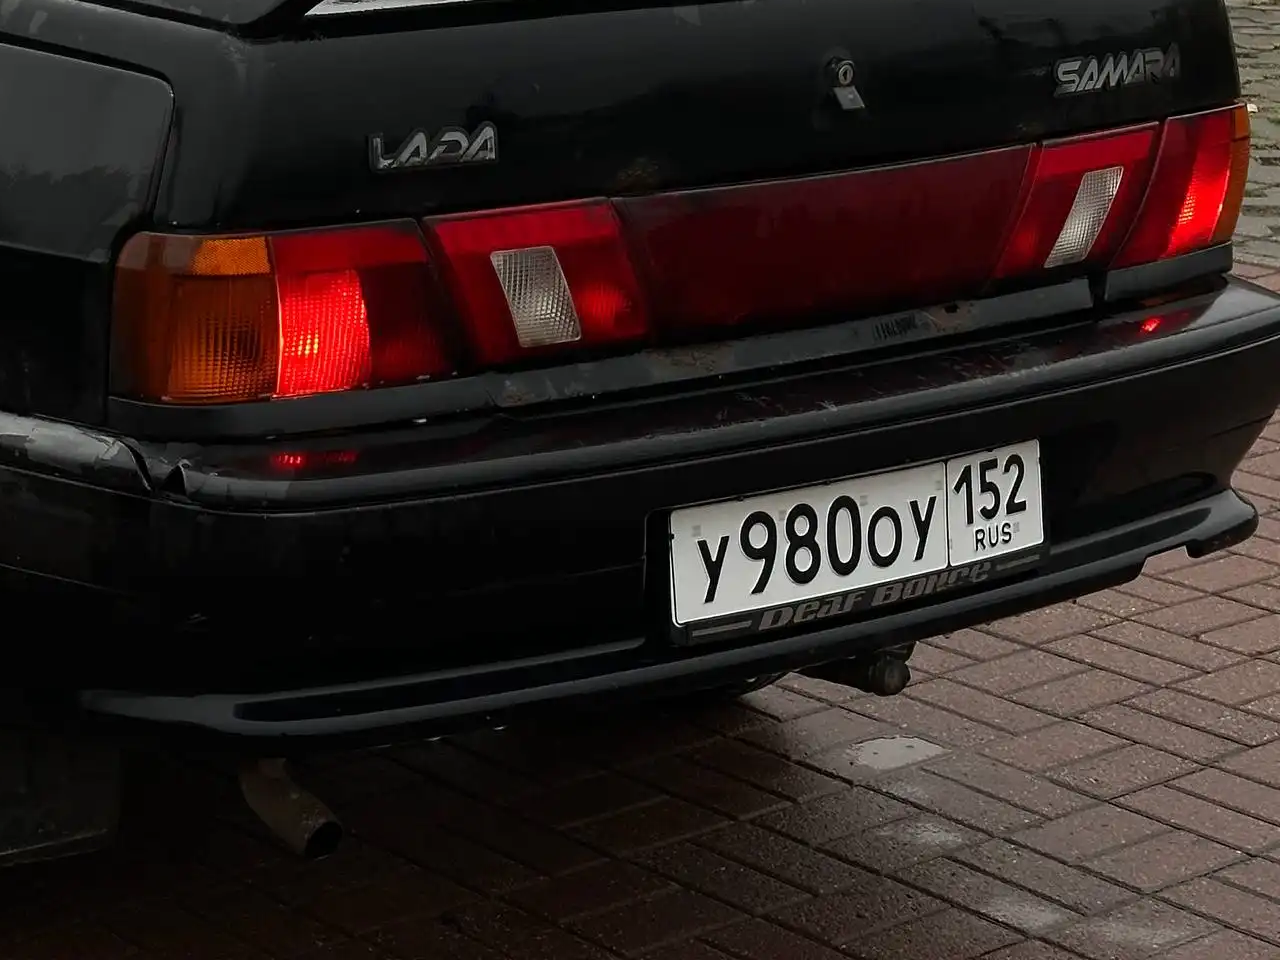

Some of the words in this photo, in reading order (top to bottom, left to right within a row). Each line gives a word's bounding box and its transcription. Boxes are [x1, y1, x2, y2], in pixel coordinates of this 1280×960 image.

[1055, 45, 1181, 96] SAMARA
[372, 125, 496, 170] LADA
[952, 453, 1027, 526] 152
[974, 522, 1013, 552] RUS
